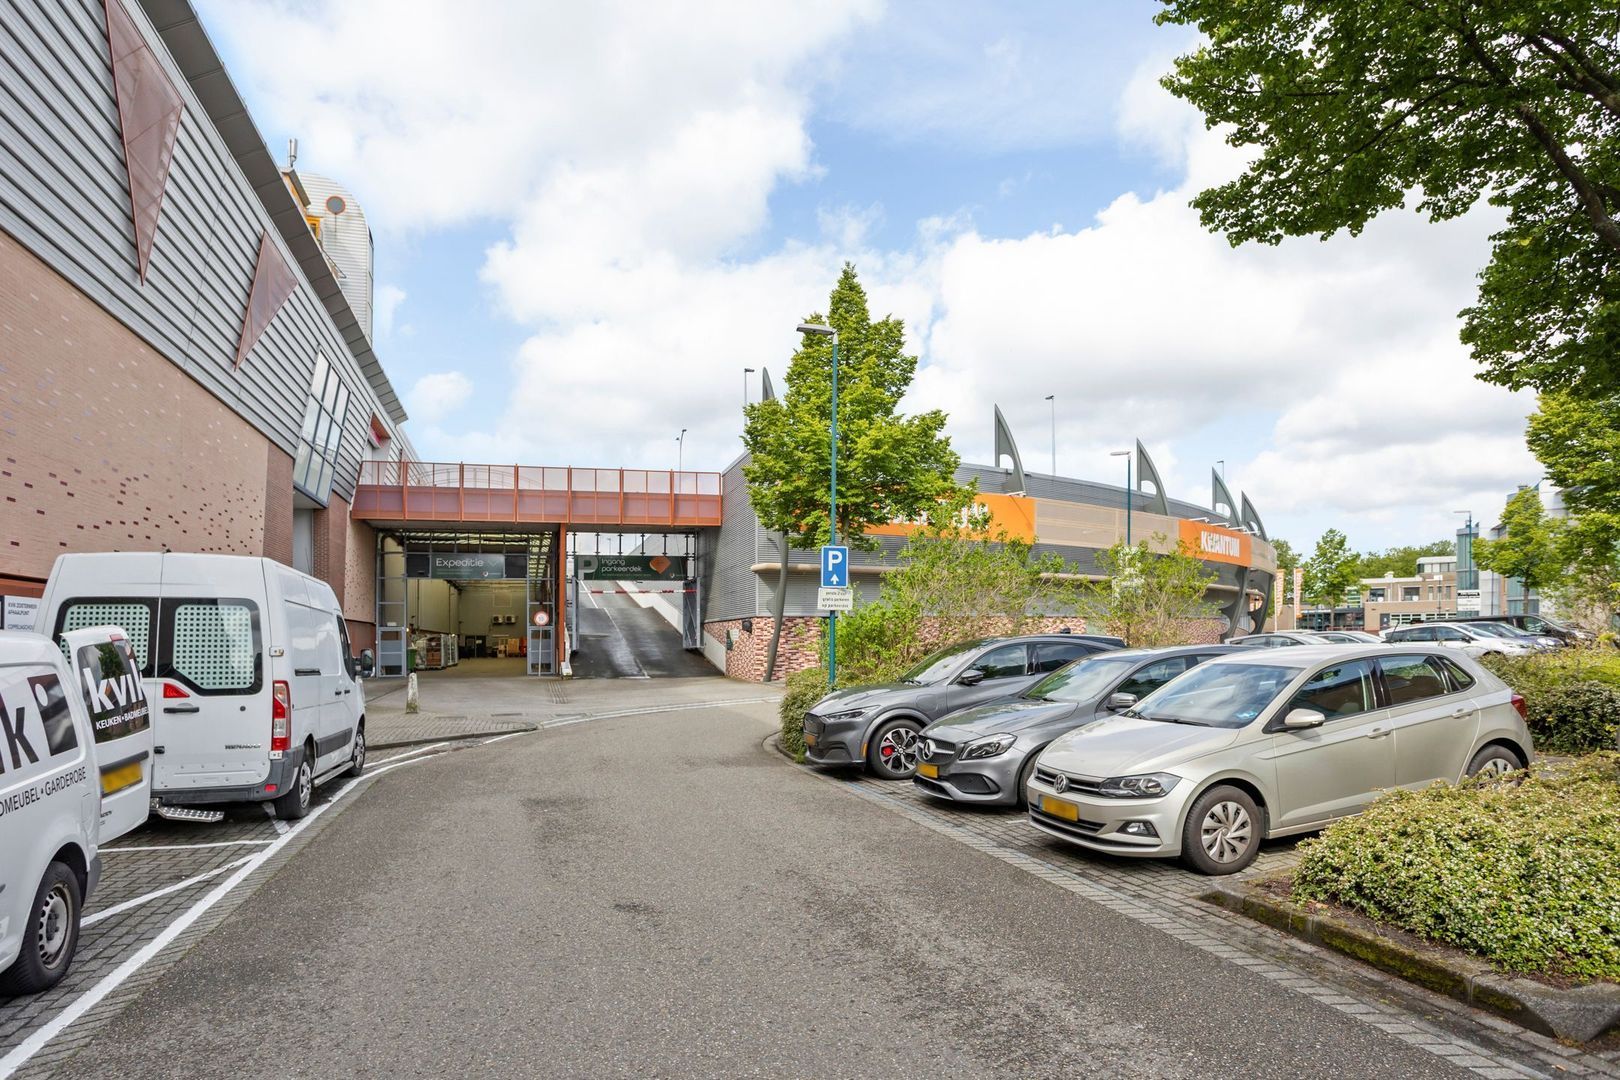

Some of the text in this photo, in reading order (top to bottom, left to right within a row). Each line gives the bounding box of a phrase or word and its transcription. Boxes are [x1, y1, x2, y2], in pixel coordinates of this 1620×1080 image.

[435, 557, 485, 569] Expeditie
[601, 558, 626, 566] Ingang
[828, 550, 843, 571] P
[601, 565, 643, 573] parkeerdek
[96, 715, 122, 730] KEUKEN
[45, 766, 87, 796] GARDEROBE
